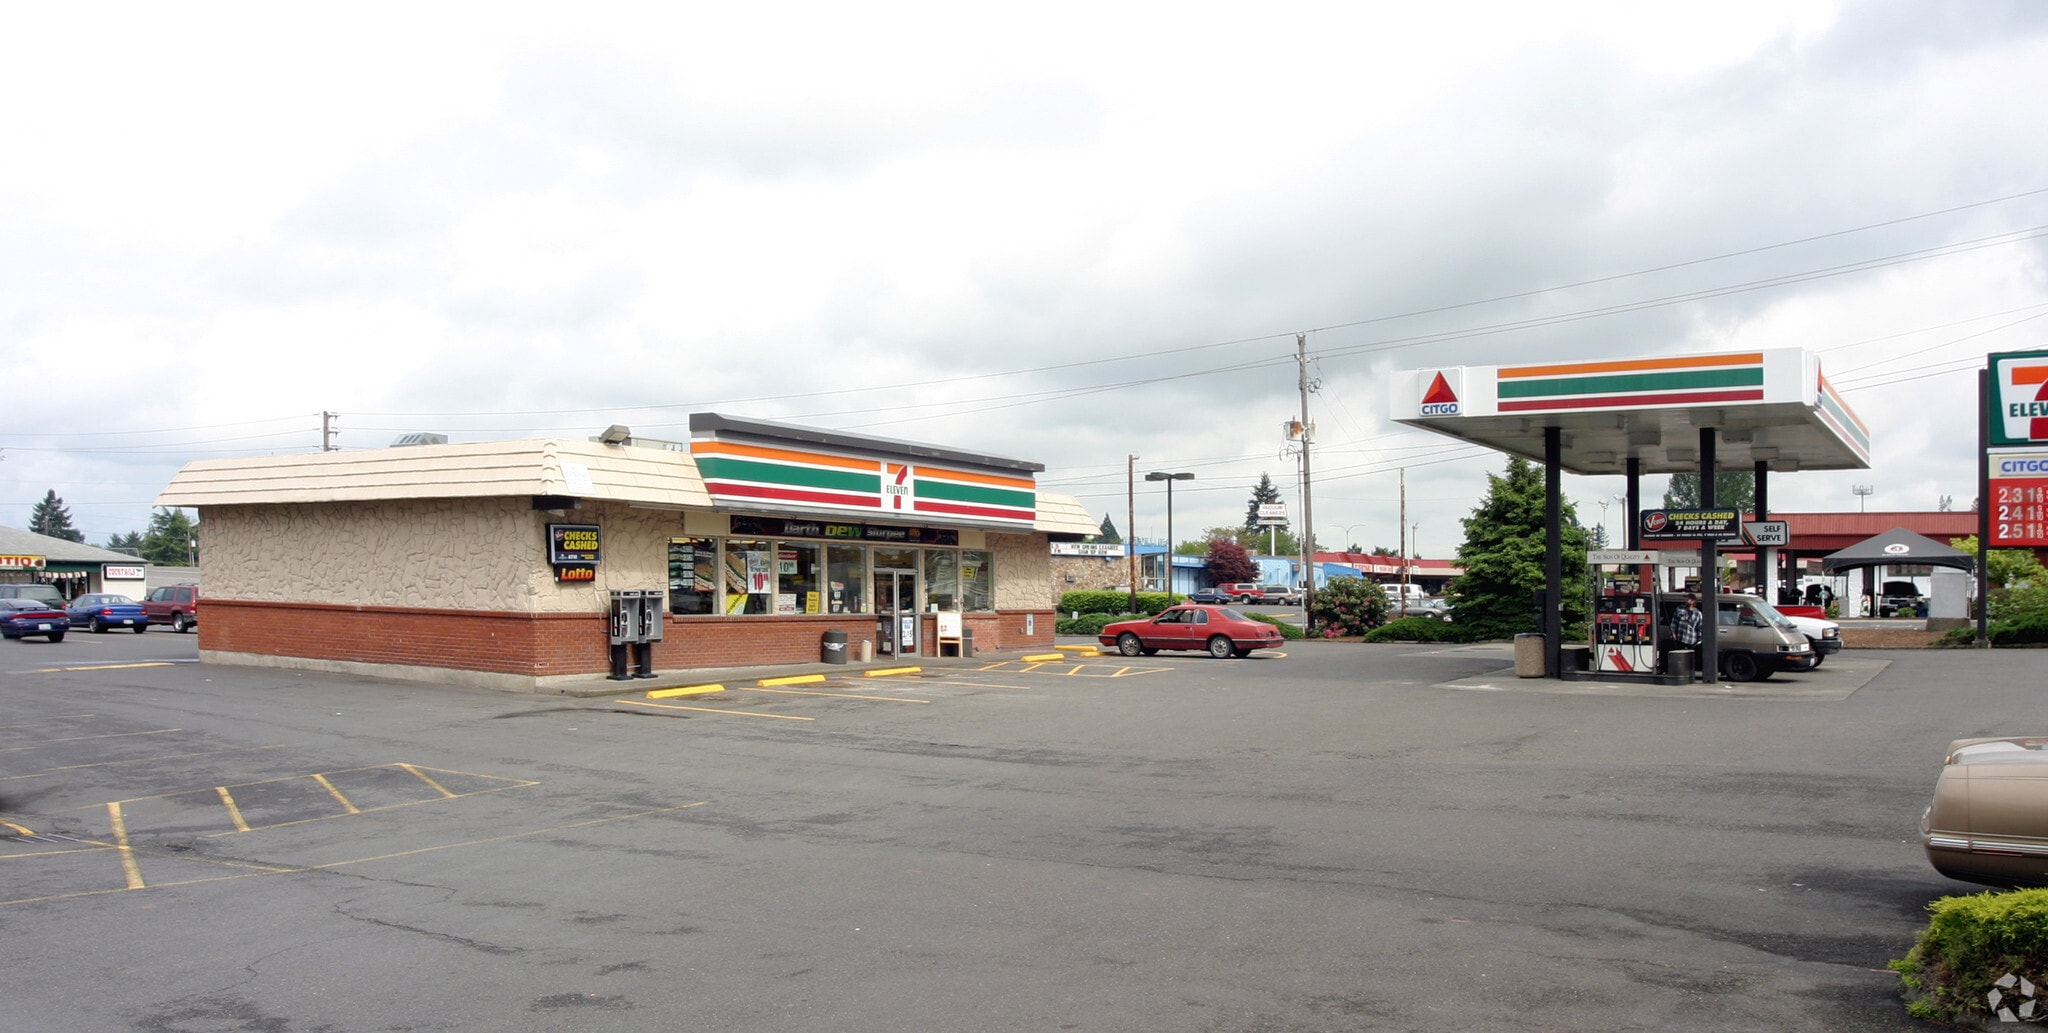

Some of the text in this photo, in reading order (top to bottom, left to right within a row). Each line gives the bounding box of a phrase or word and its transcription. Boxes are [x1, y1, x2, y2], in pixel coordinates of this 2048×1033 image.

[1421, 403, 1458, 415] CITGO
[1668, 512, 1735, 520] CHECKS CASHED
[1763, 525, 1781, 533] SELF
[564, 531, 597, 540] CHECKS
[1756, 534, 1781, 542] SERVE
[563, 541, 598, 550] CASHED
[108, 566, 136, 576] COCKTAILS
[561, 568, 593, 580] Lotto
